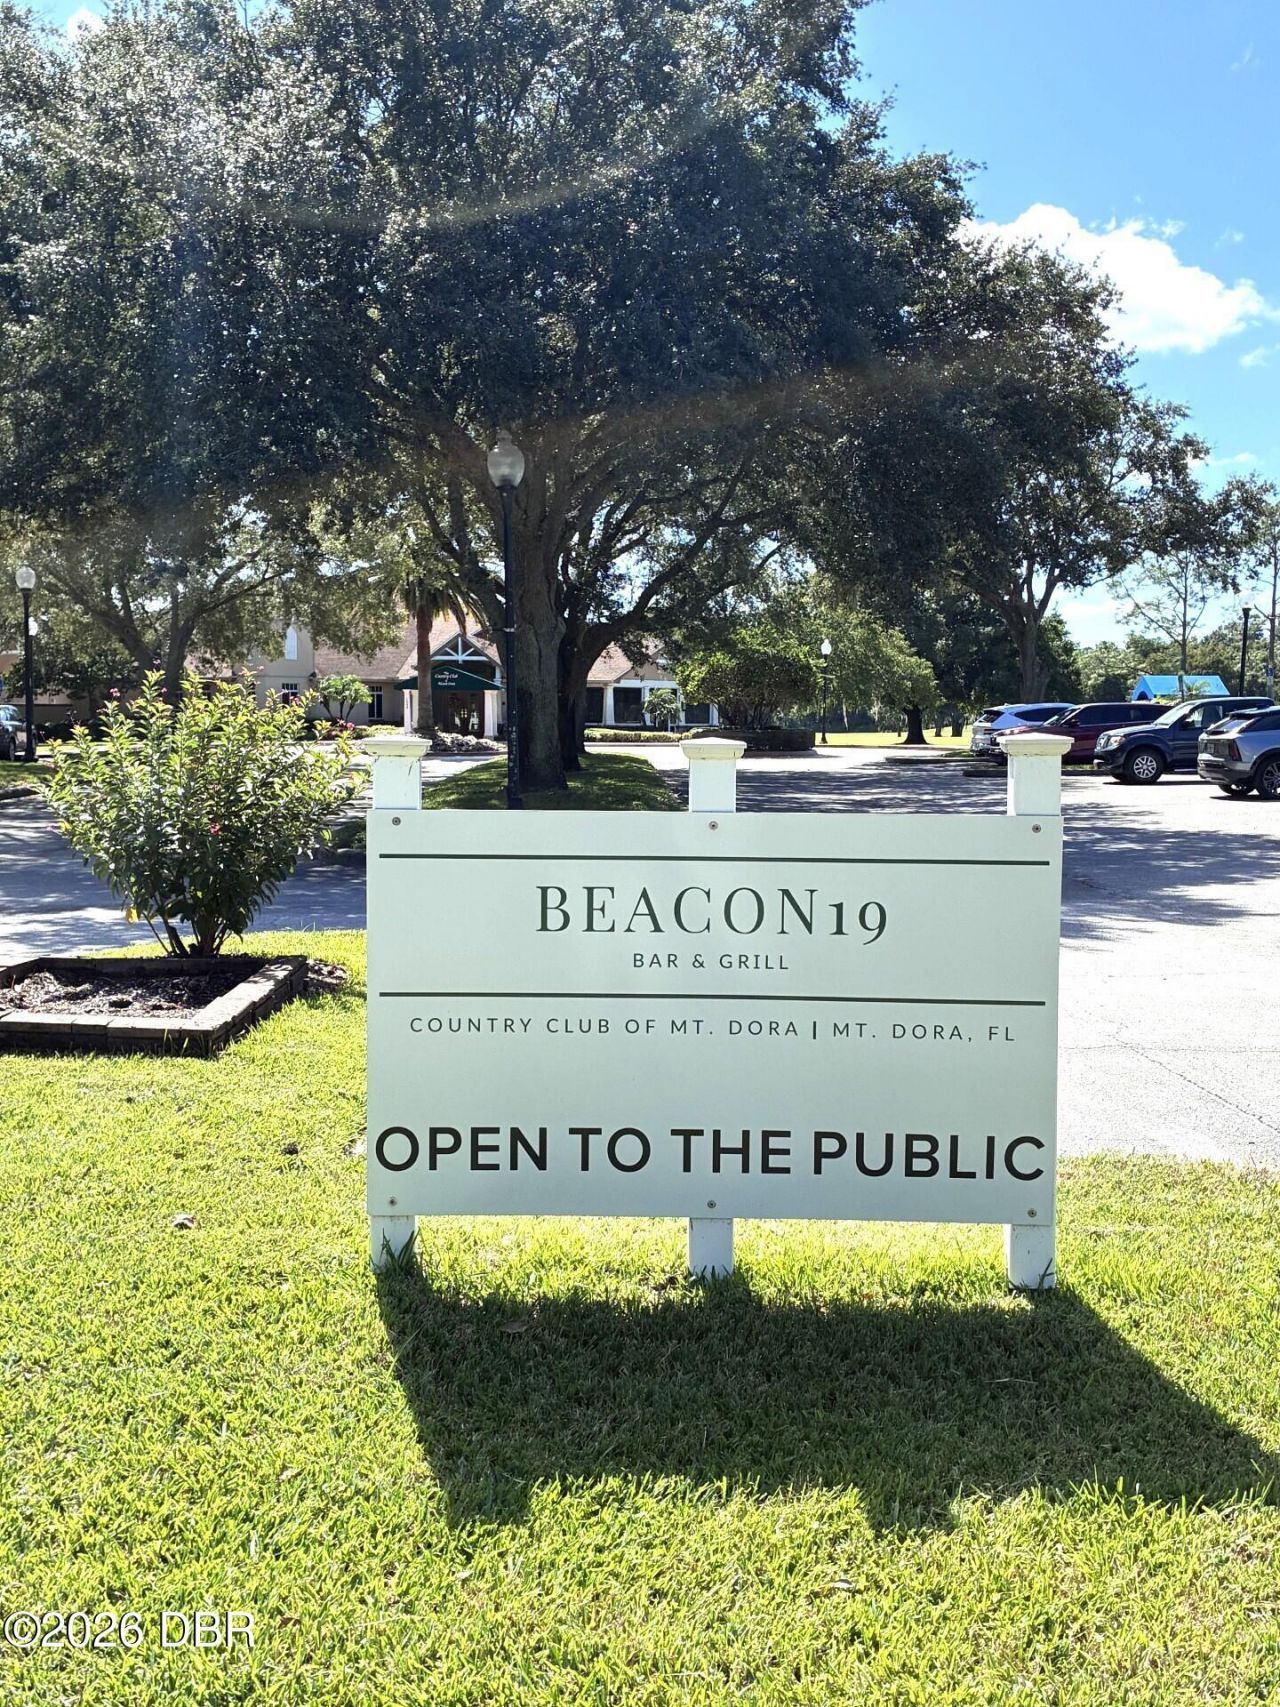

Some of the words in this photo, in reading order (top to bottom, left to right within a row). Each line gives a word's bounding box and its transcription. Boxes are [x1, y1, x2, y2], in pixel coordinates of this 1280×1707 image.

[535, 885, 888, 946] BEACON19
[633, 952, 679, 969] BAR
[691, 953, 706, 969] &
[719, 953, 789, 970] GRILL
[409, 1017, 532, 1033] COUNTRY
[546, 1018, 610, 1034] CLUB
[624, 1018, 656, 1035] OF
[670, 1019, 715, 1035] MT.
[729, 1020, 799, 1036] DORA
[833, 1022, 877, 1038] MT.
[892, 1023, 973, 1043] DORA,
[988, 1025, 1015, 1042] FL
[375, 1125, 548, 1172] OPEN
[568, 1127, 651, 1173] TO
[670, 1128, 792, 1175] THE
[813, 1130, 1046, 1182] PUBLIC
